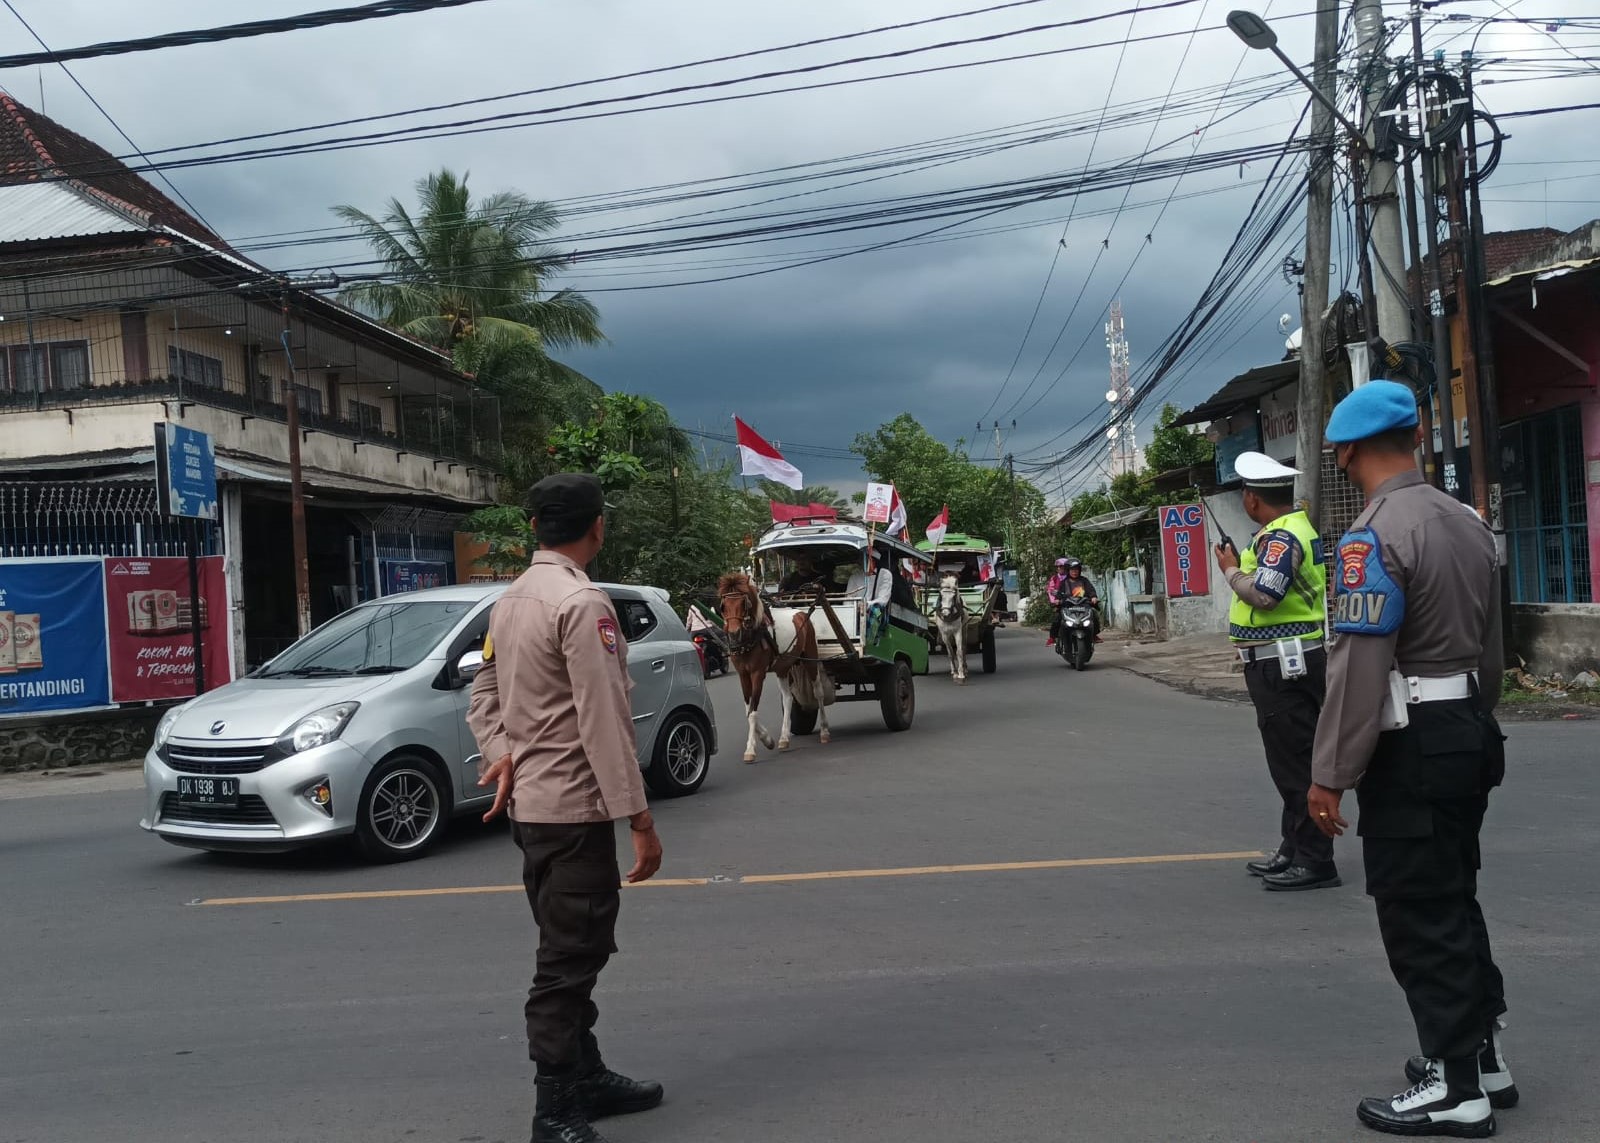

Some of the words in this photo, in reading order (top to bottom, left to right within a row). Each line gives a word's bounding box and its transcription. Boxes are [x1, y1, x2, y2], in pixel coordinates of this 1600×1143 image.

[1163, 505, 1203, 529] AC
[1174, 530, 1193, 597] MOBIL
[136, 665, 144, 677] &
[181, 779, 192, 794] DK
[194, 779, 214, 795] 1938
